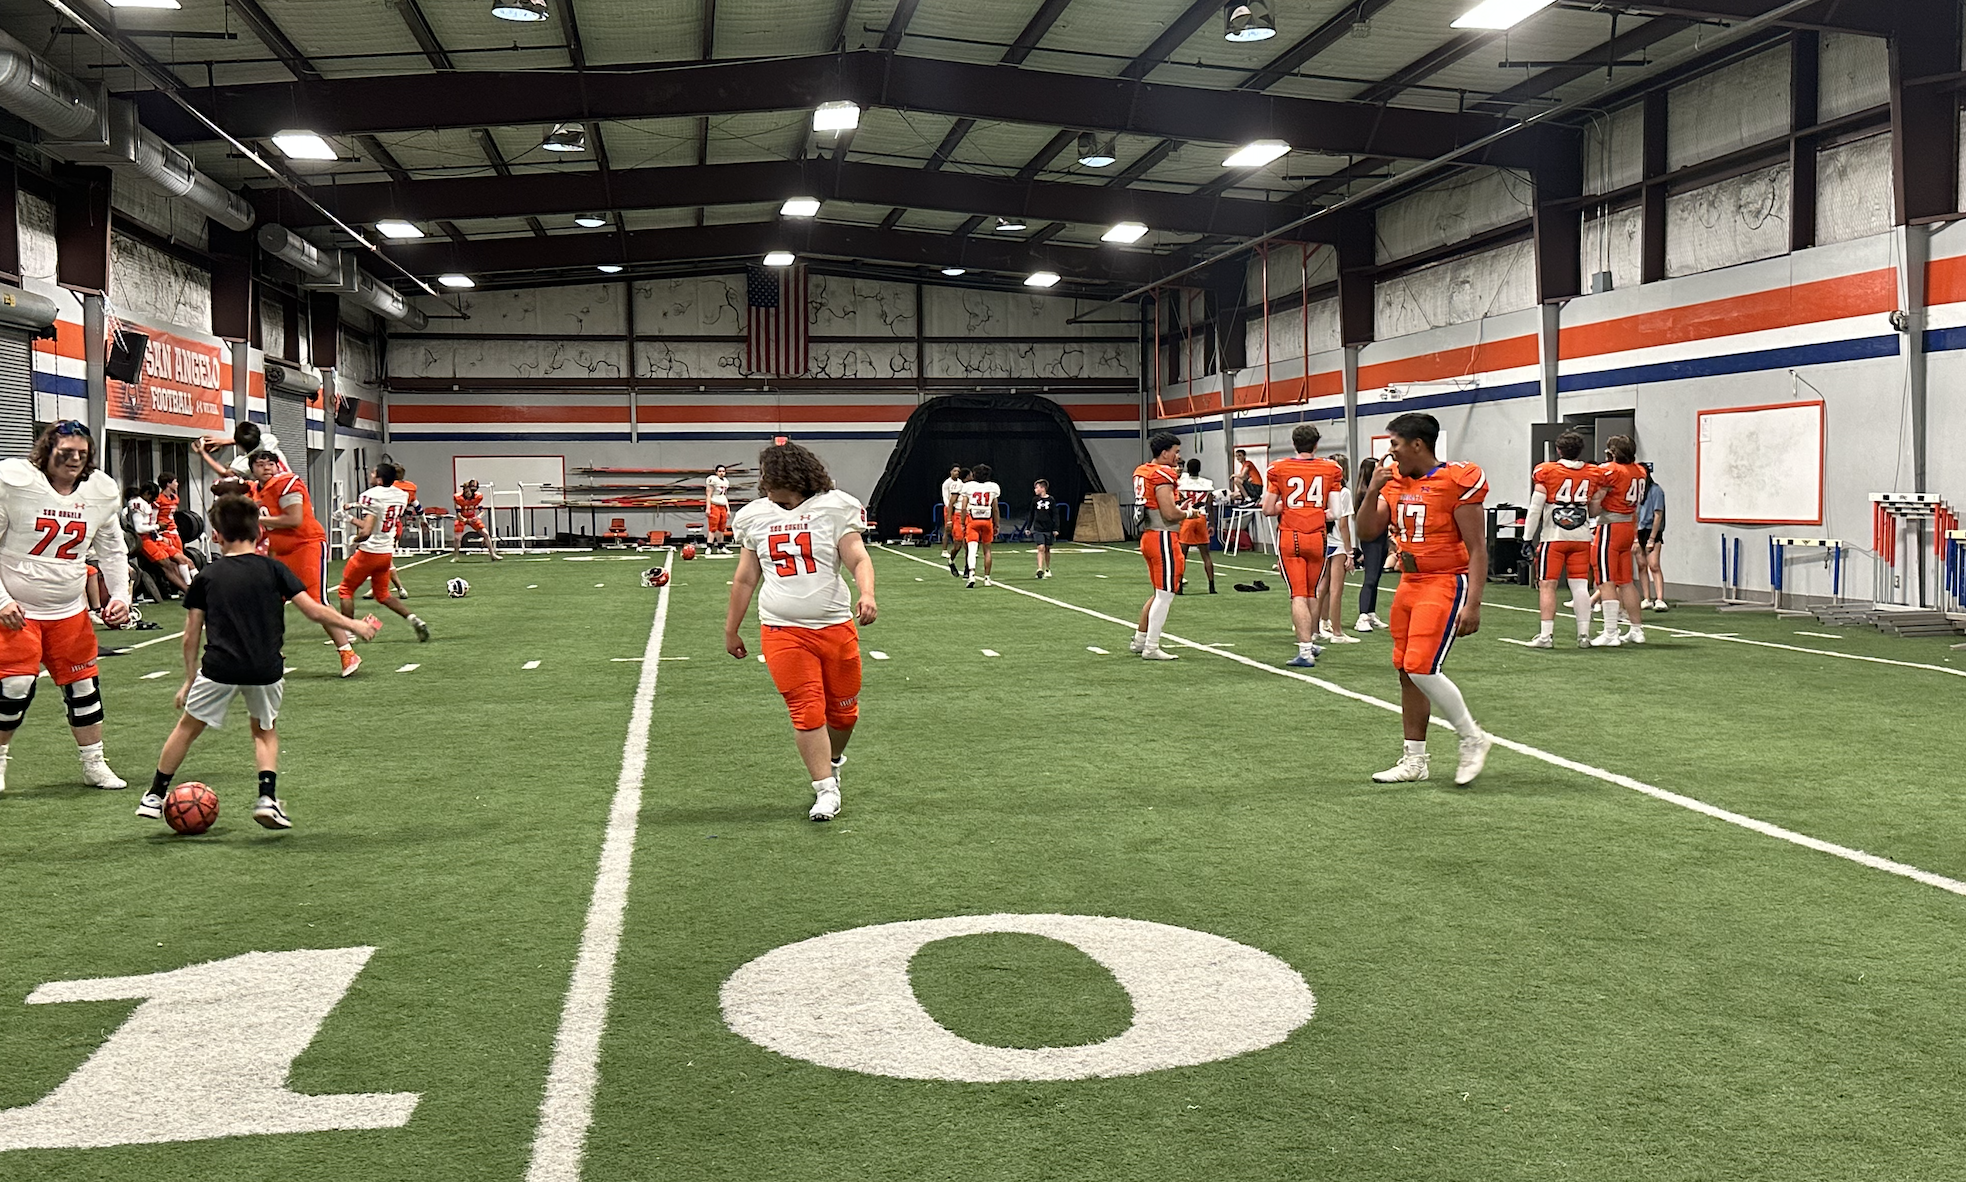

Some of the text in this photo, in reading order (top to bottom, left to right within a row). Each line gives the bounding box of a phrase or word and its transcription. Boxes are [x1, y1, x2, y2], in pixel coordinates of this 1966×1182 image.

[145, 339, 221, 391] SAN ANGELO
[150, 386, 194, 417] FOOTBALL
[1286, 475, 1324, 509] 24
[1555, 478, 1590, 503] 44
[43, 508, 82, 519] SAN ANGELO
[1397, 503, 1427, 543] 17
[28, 516, 87, 560] 72
[768, 531, 817, 578] 51
